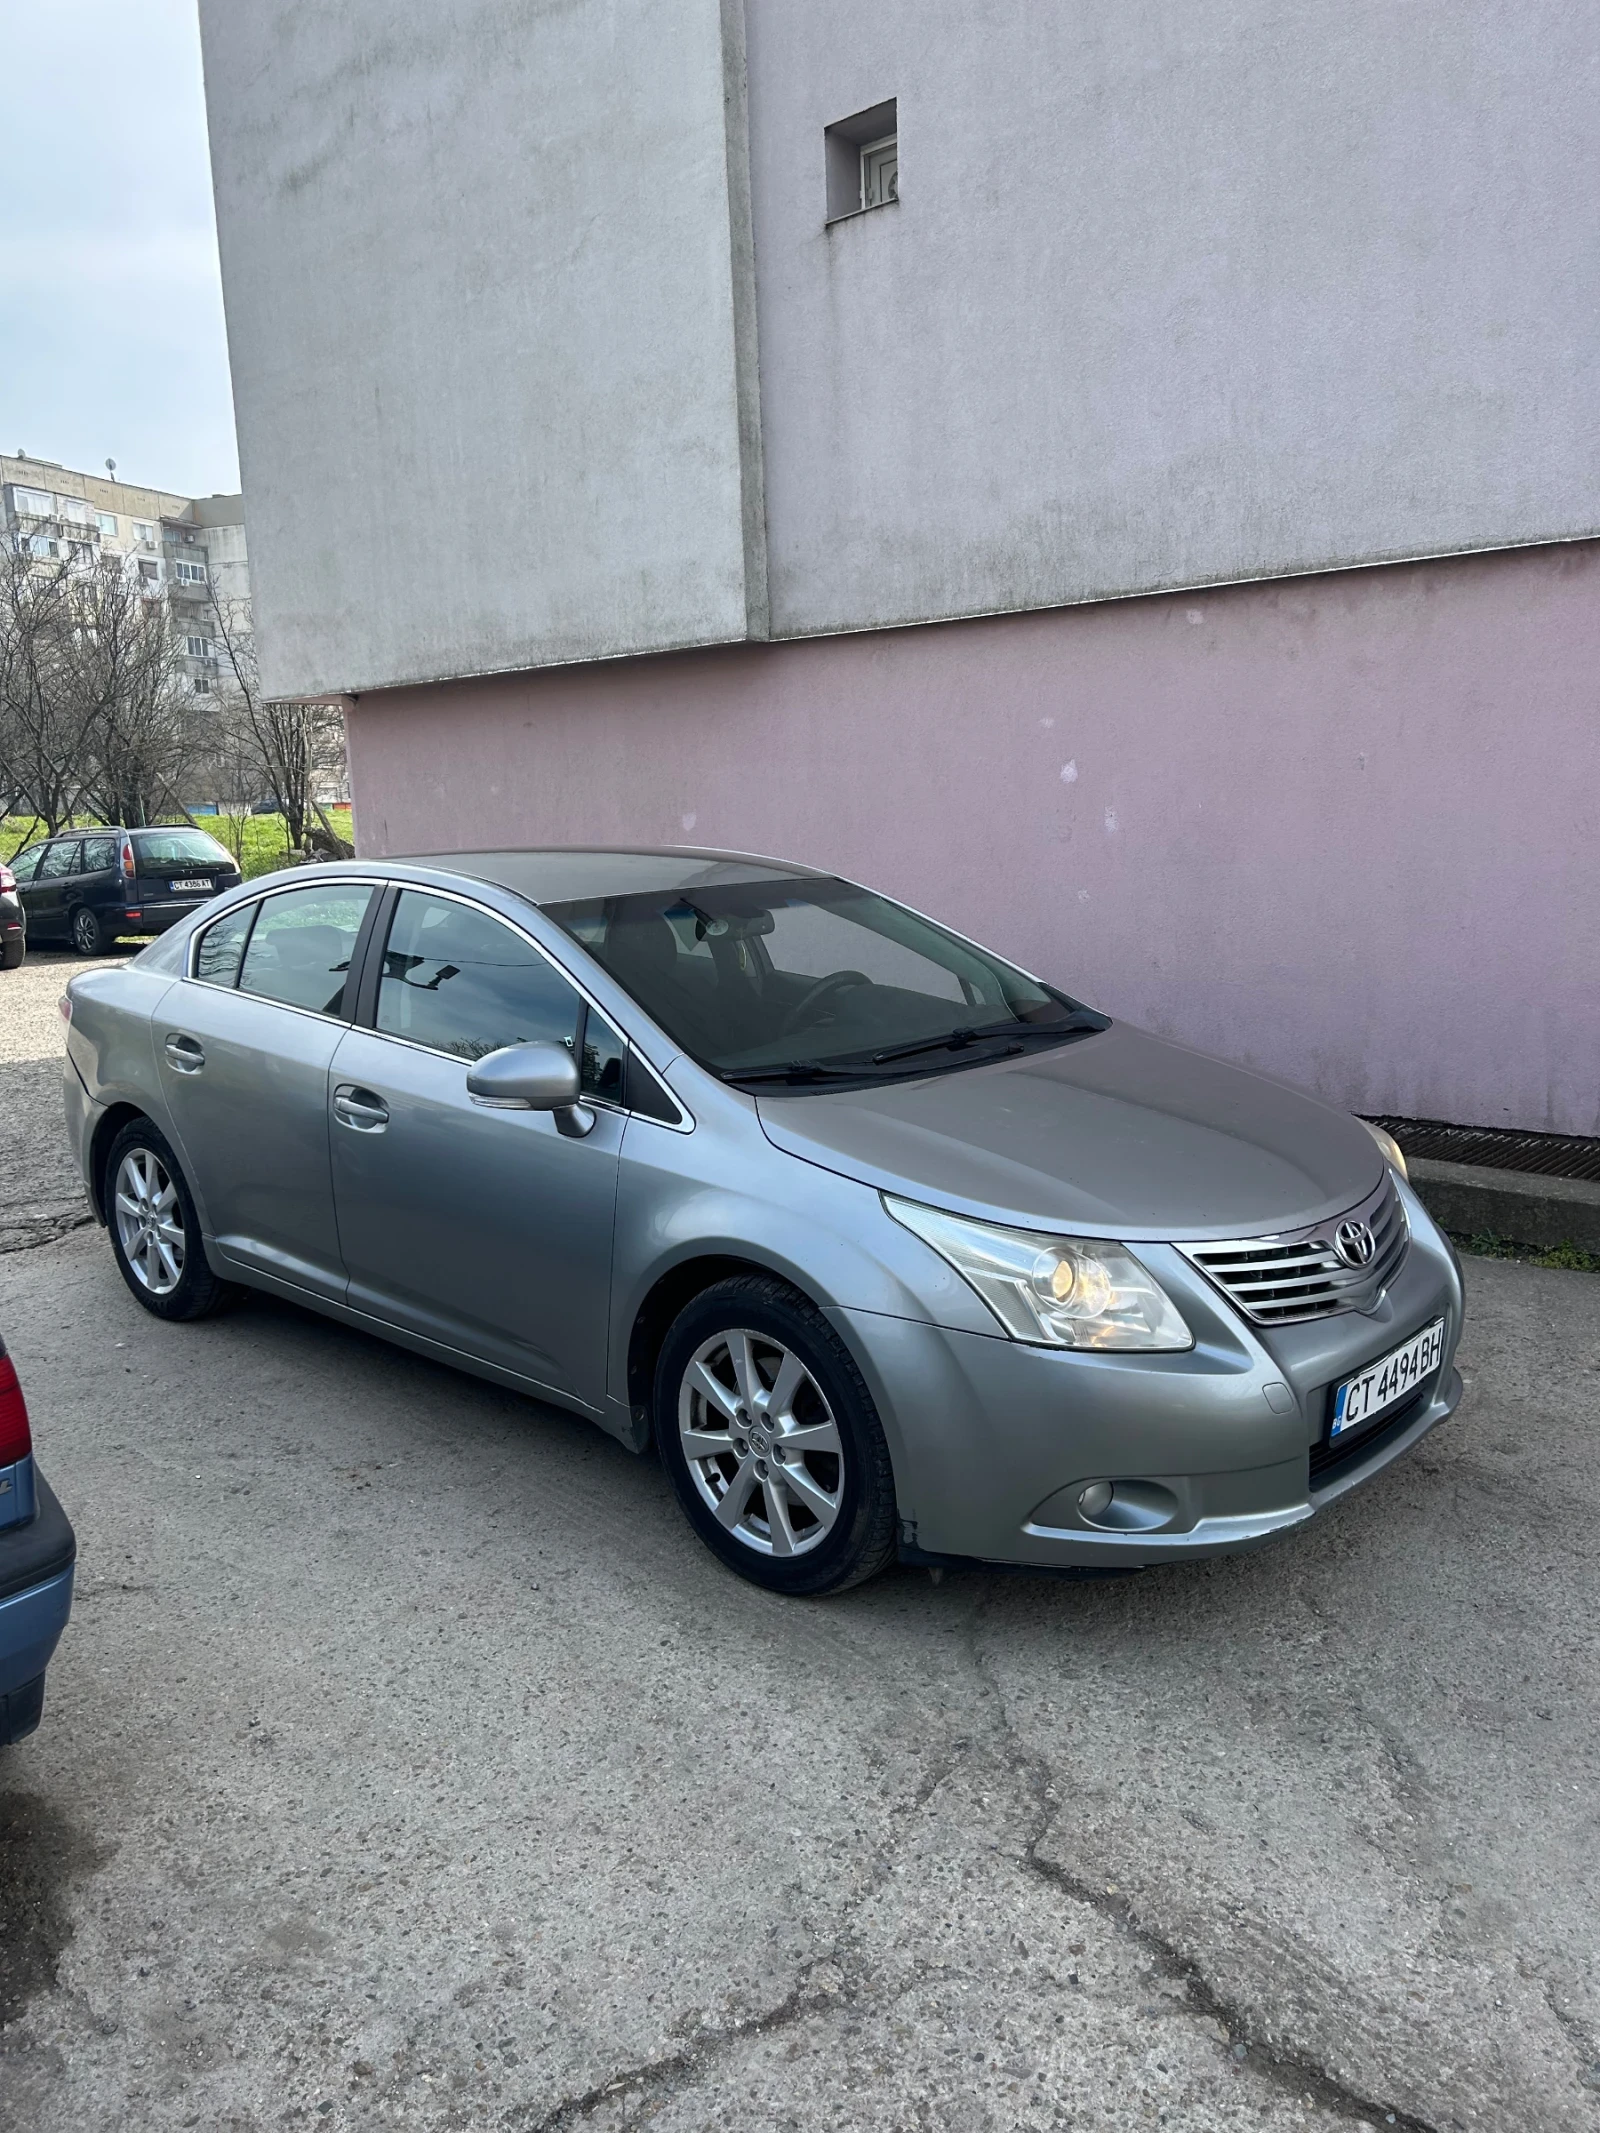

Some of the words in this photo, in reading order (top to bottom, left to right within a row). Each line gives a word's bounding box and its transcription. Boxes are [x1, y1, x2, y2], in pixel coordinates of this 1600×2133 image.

[1346, 1374, 1375, 1422] CT
[1377, 1344, 1419, 1403] 4494
[1420, 1327, 1442, 1375] BH
